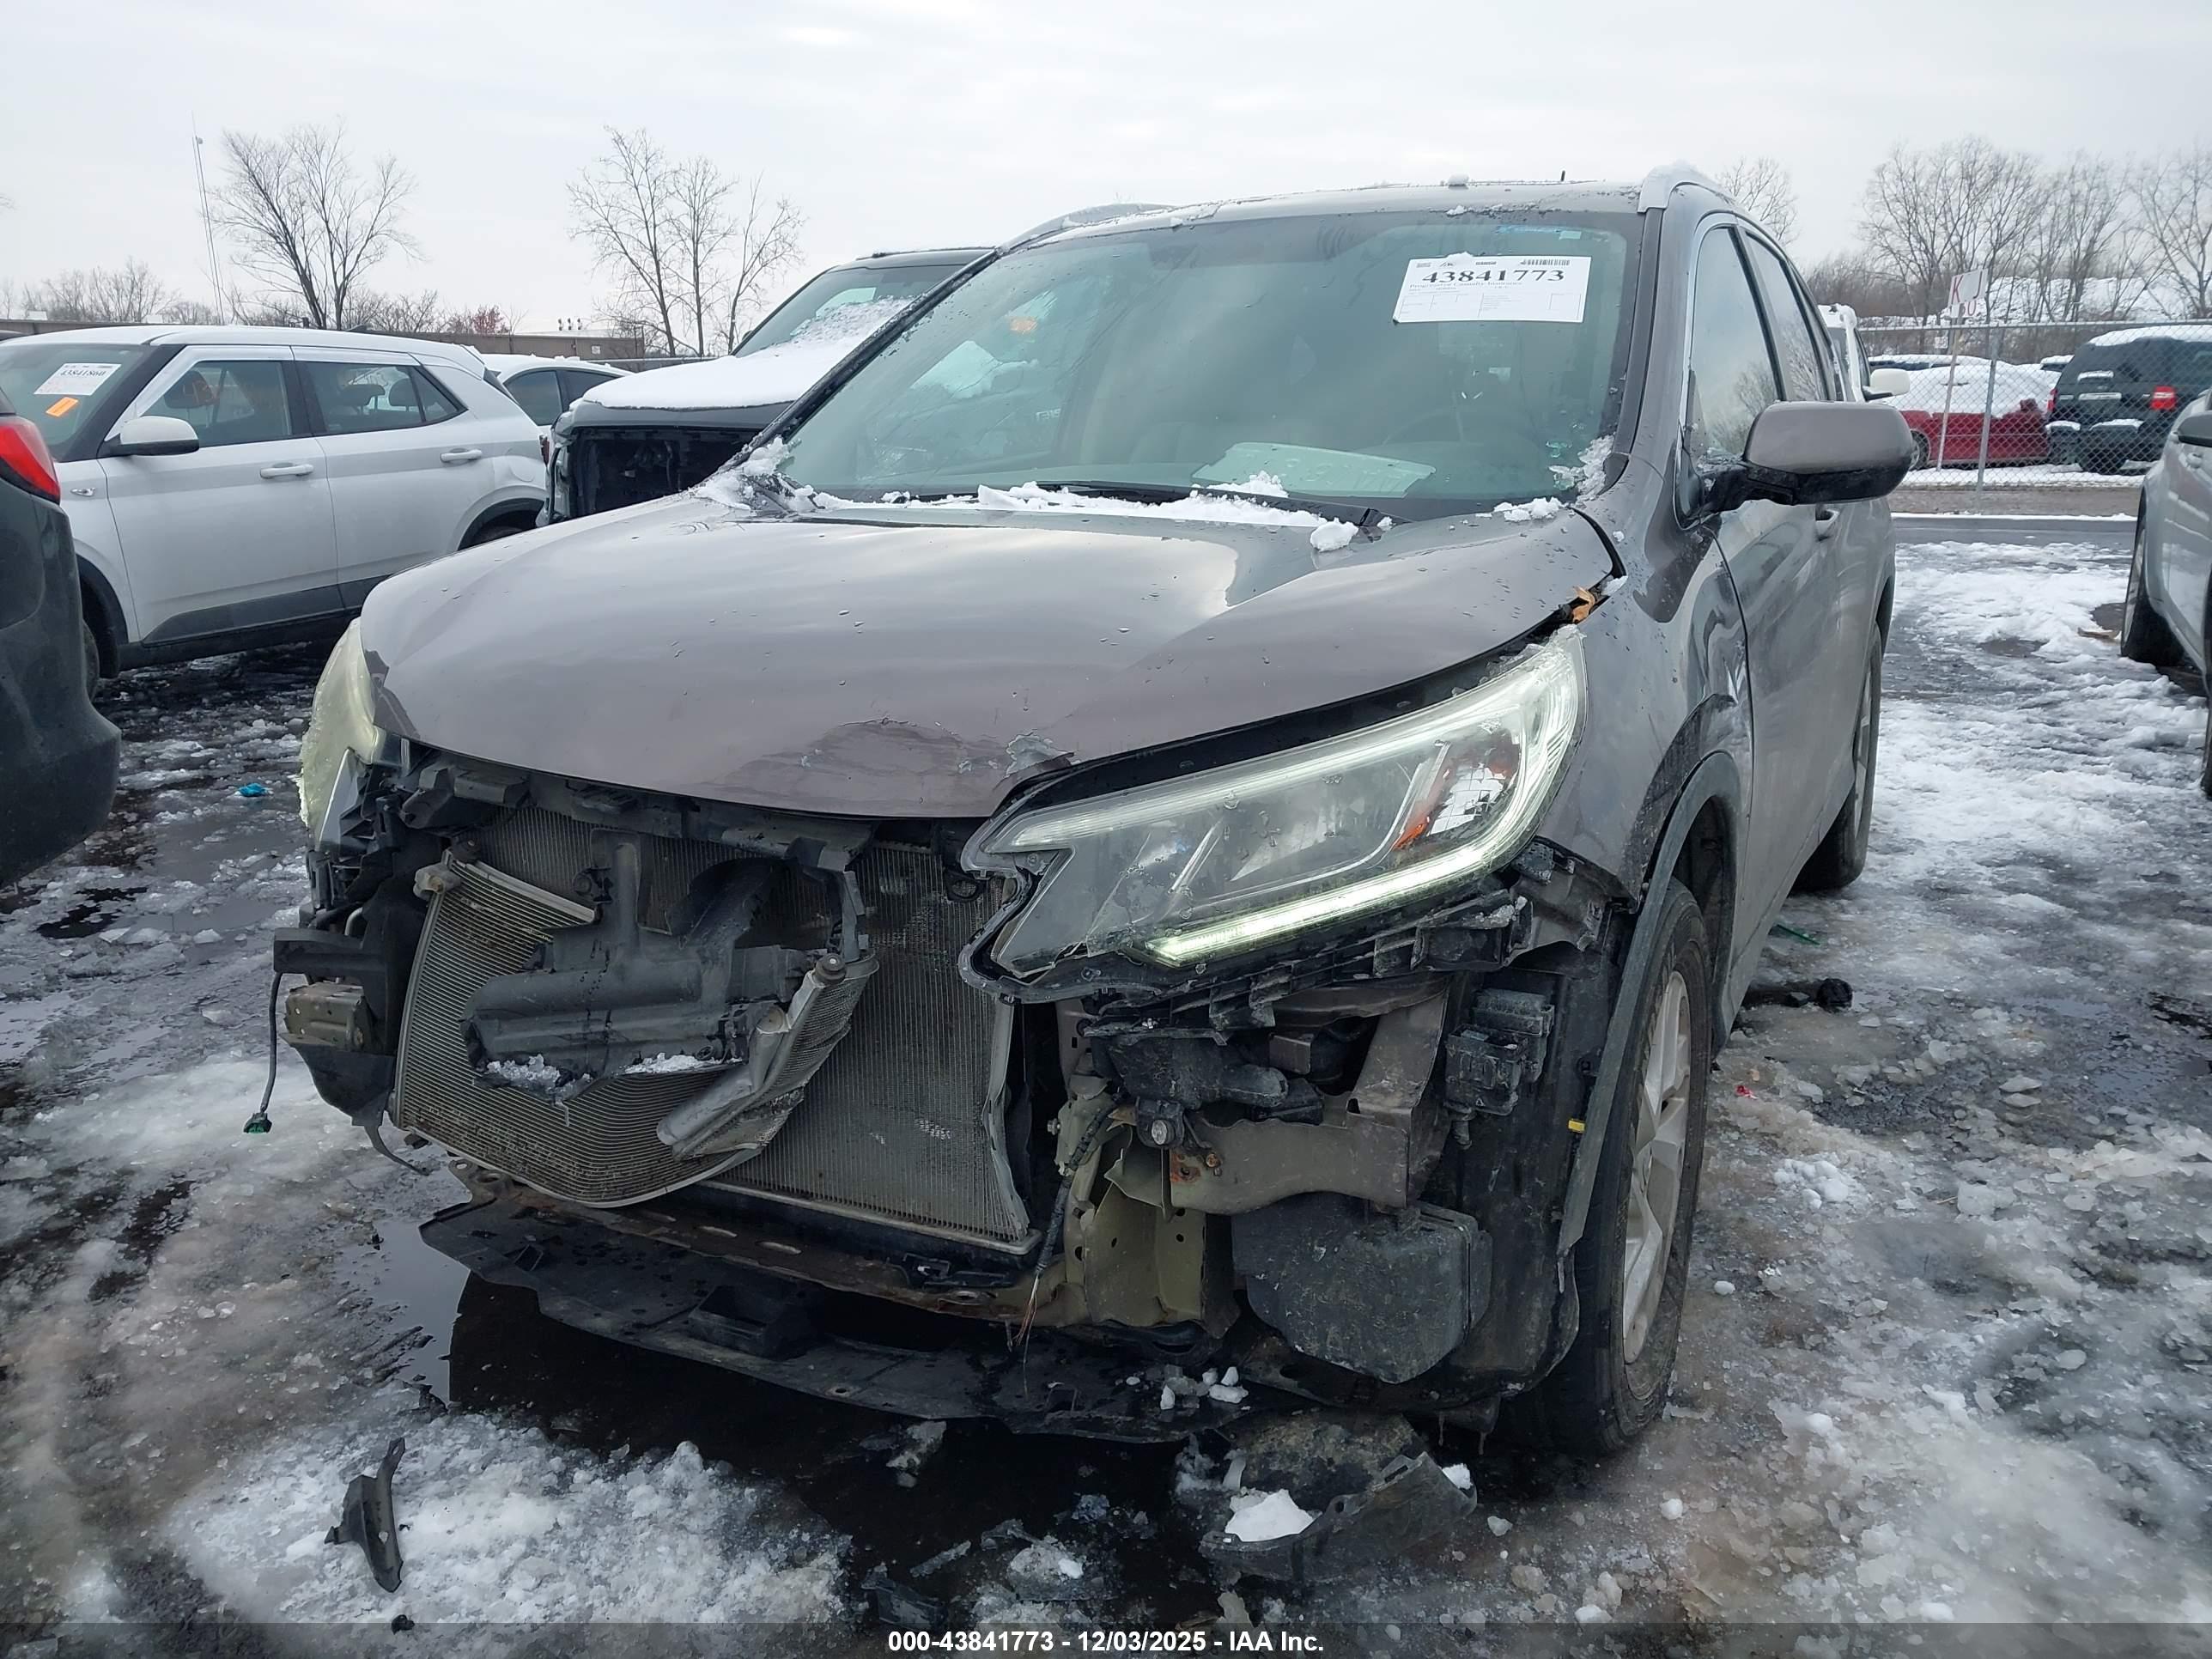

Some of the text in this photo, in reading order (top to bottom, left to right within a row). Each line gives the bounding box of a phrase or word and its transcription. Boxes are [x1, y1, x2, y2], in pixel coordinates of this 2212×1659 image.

[1422, 270, 1565, 283] 43841773
[1951, 270, 1983, 305] K J
